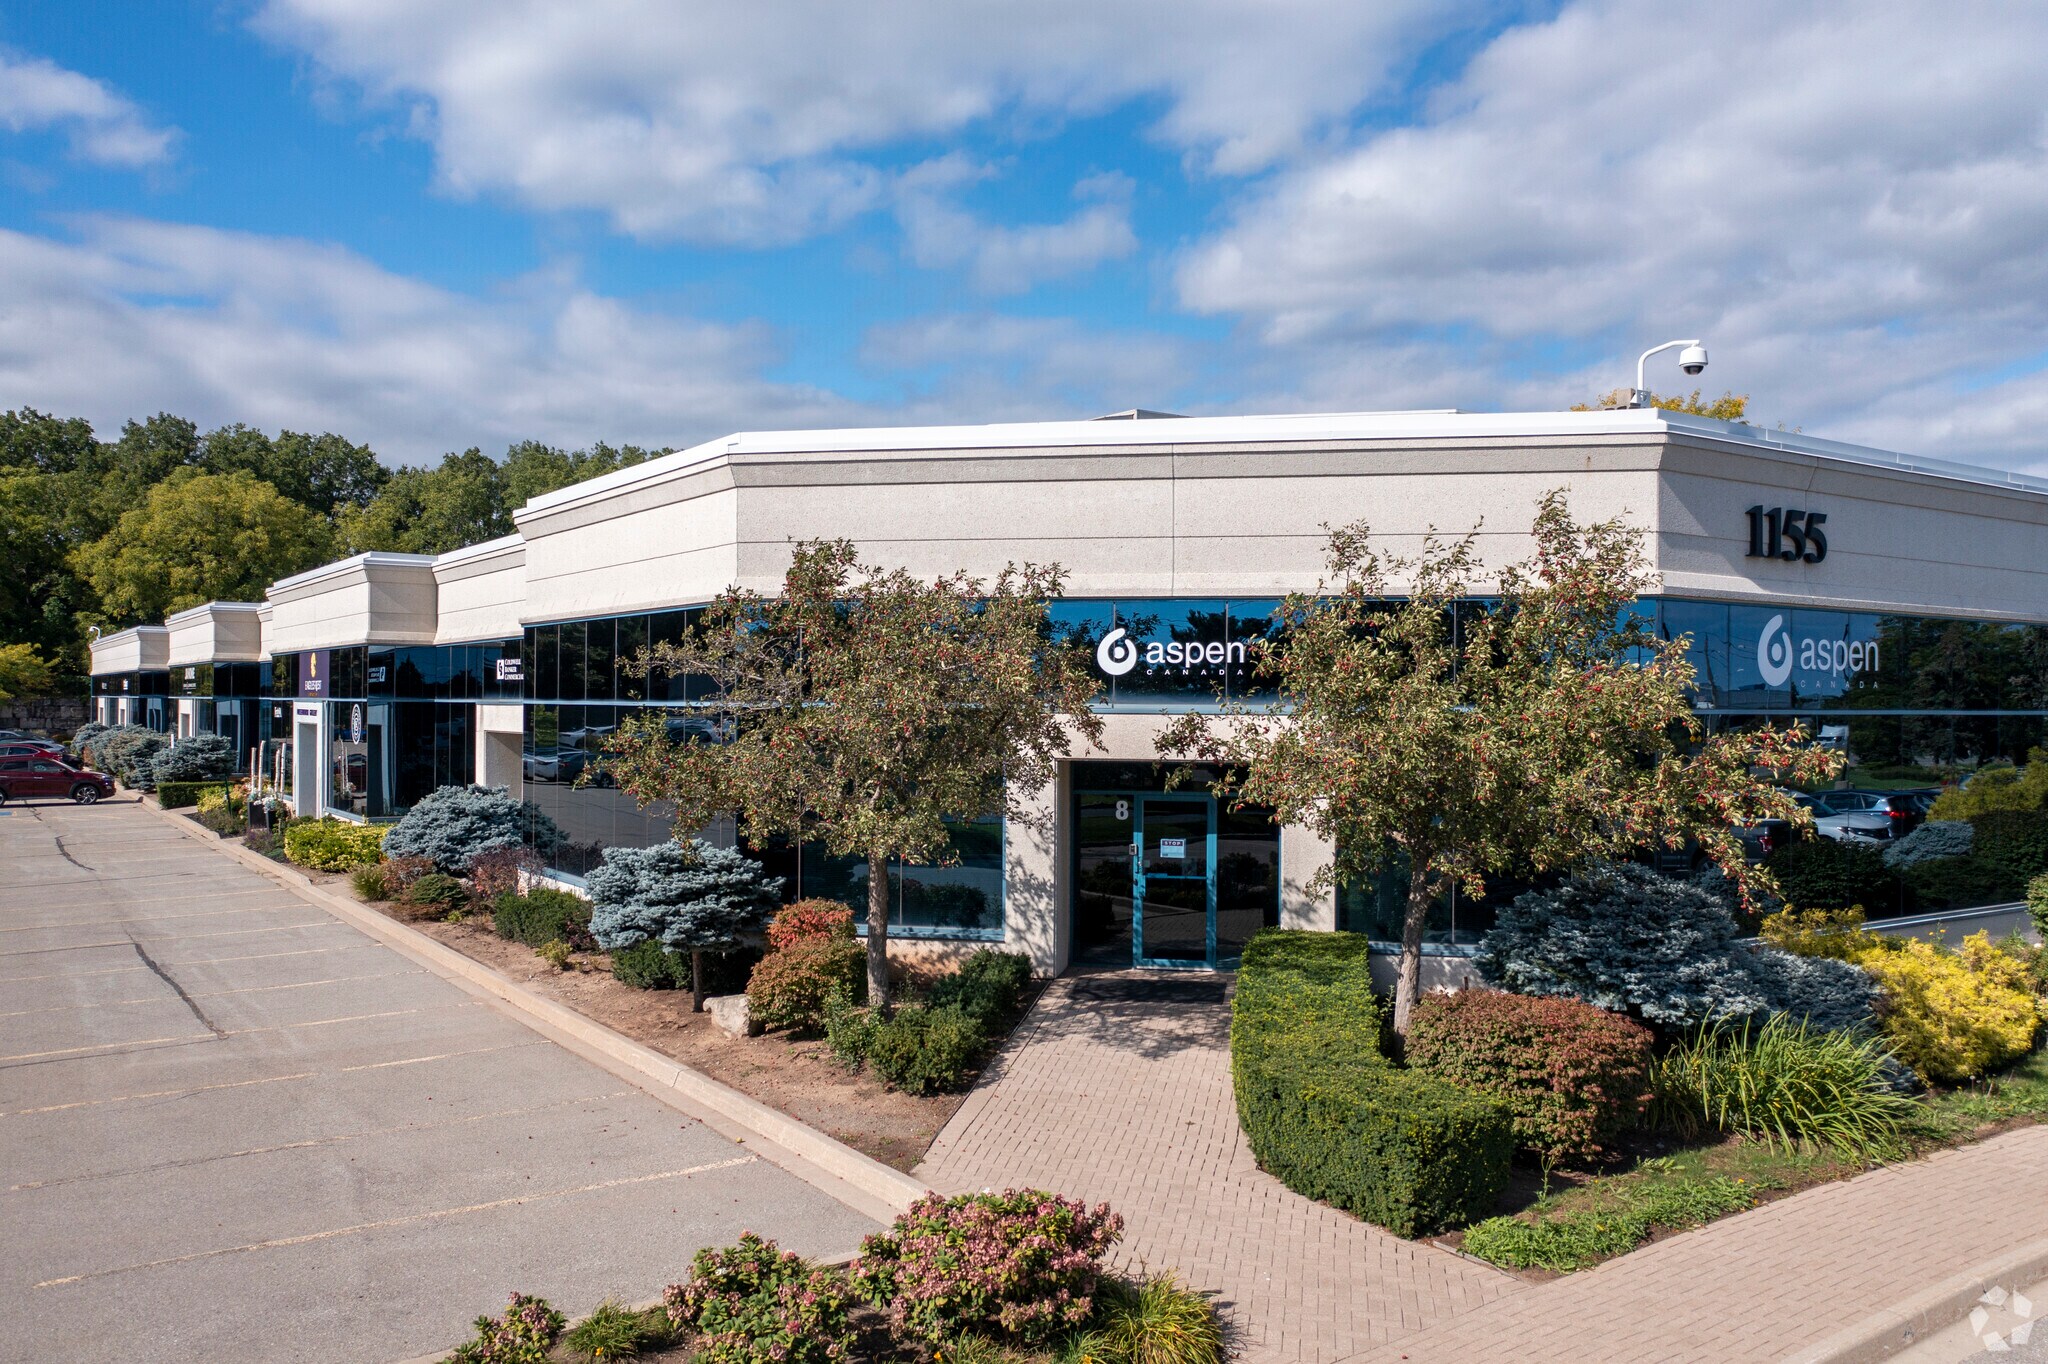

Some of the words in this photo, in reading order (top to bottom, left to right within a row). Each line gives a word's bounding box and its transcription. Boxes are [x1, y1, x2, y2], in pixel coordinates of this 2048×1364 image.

[1745, 505, 1827, 563] 1155
[1146, 642, 1245, 667] aspen
[1800, 638, 1879, 677] aspen
[1800, 680, 1879, 689] CANADA
[1115, 800, 1129, 821] 8
